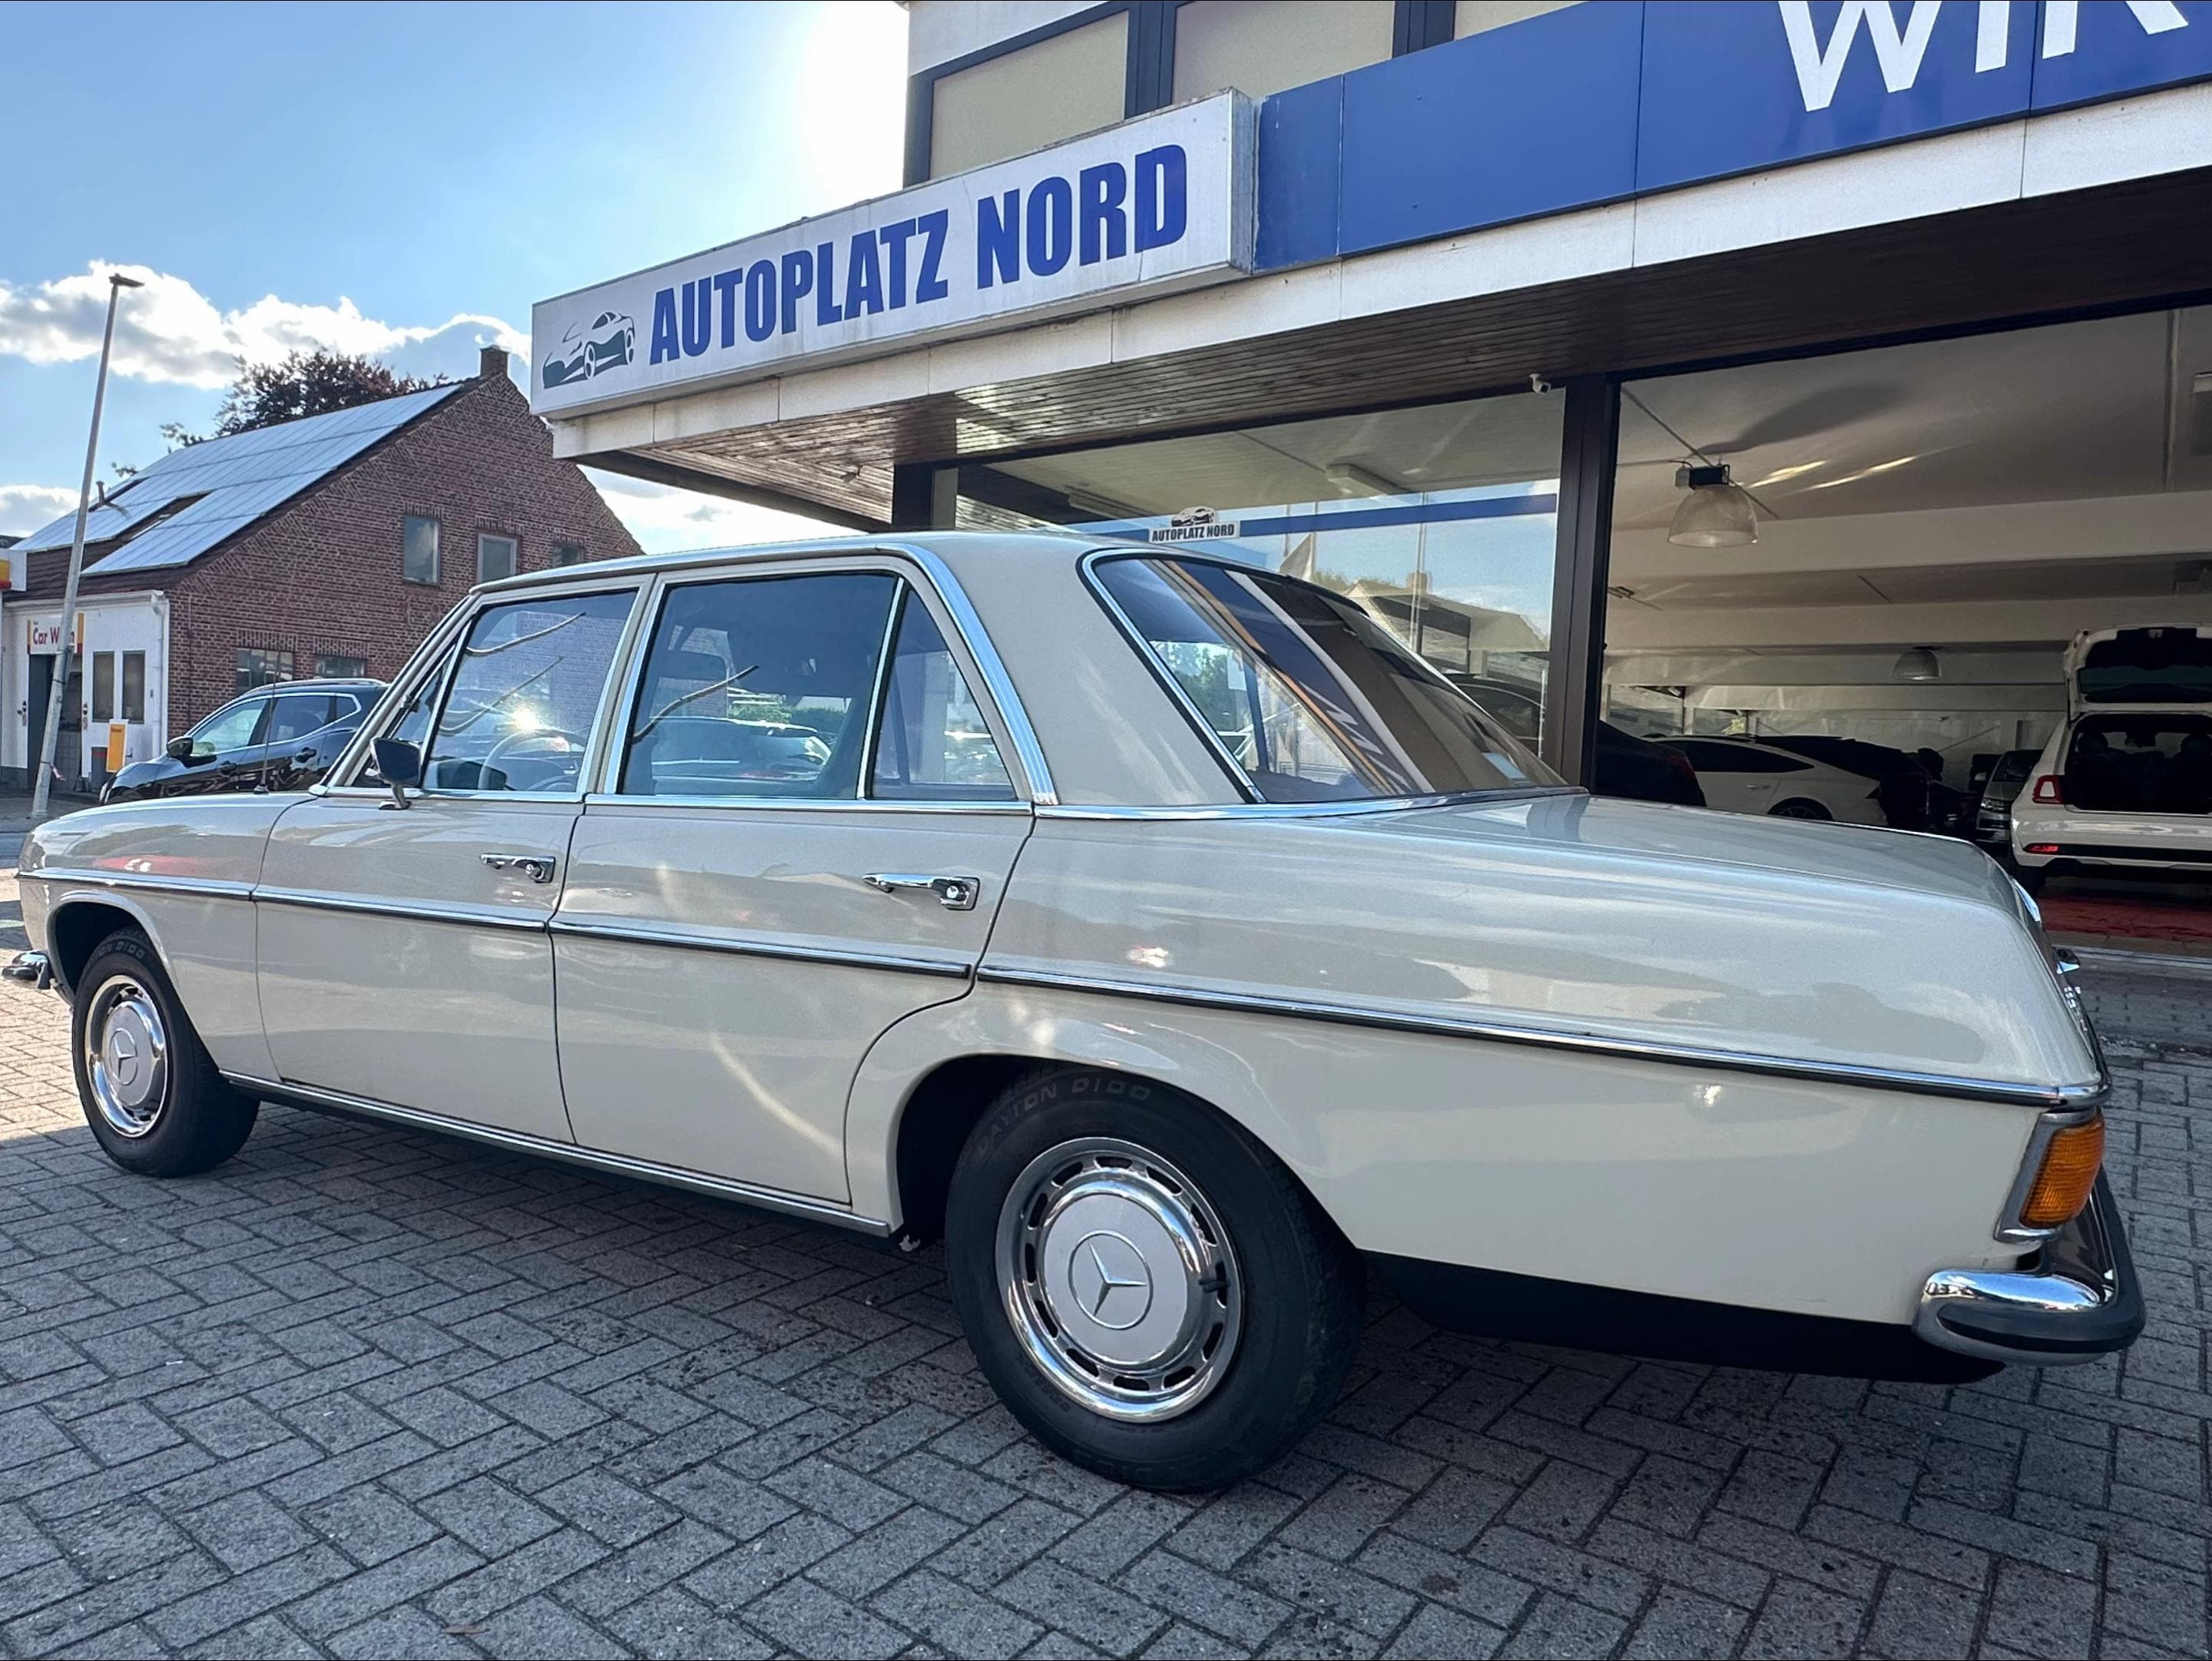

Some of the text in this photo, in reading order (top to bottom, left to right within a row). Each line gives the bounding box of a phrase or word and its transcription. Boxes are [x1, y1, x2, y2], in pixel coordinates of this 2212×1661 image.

[650, 144, 1187, 365] AUTOPLATZ NORD
[1152, 524, 1234, 542] AUTOPLATZ NORD
[33, 627, 48, 645] Car
